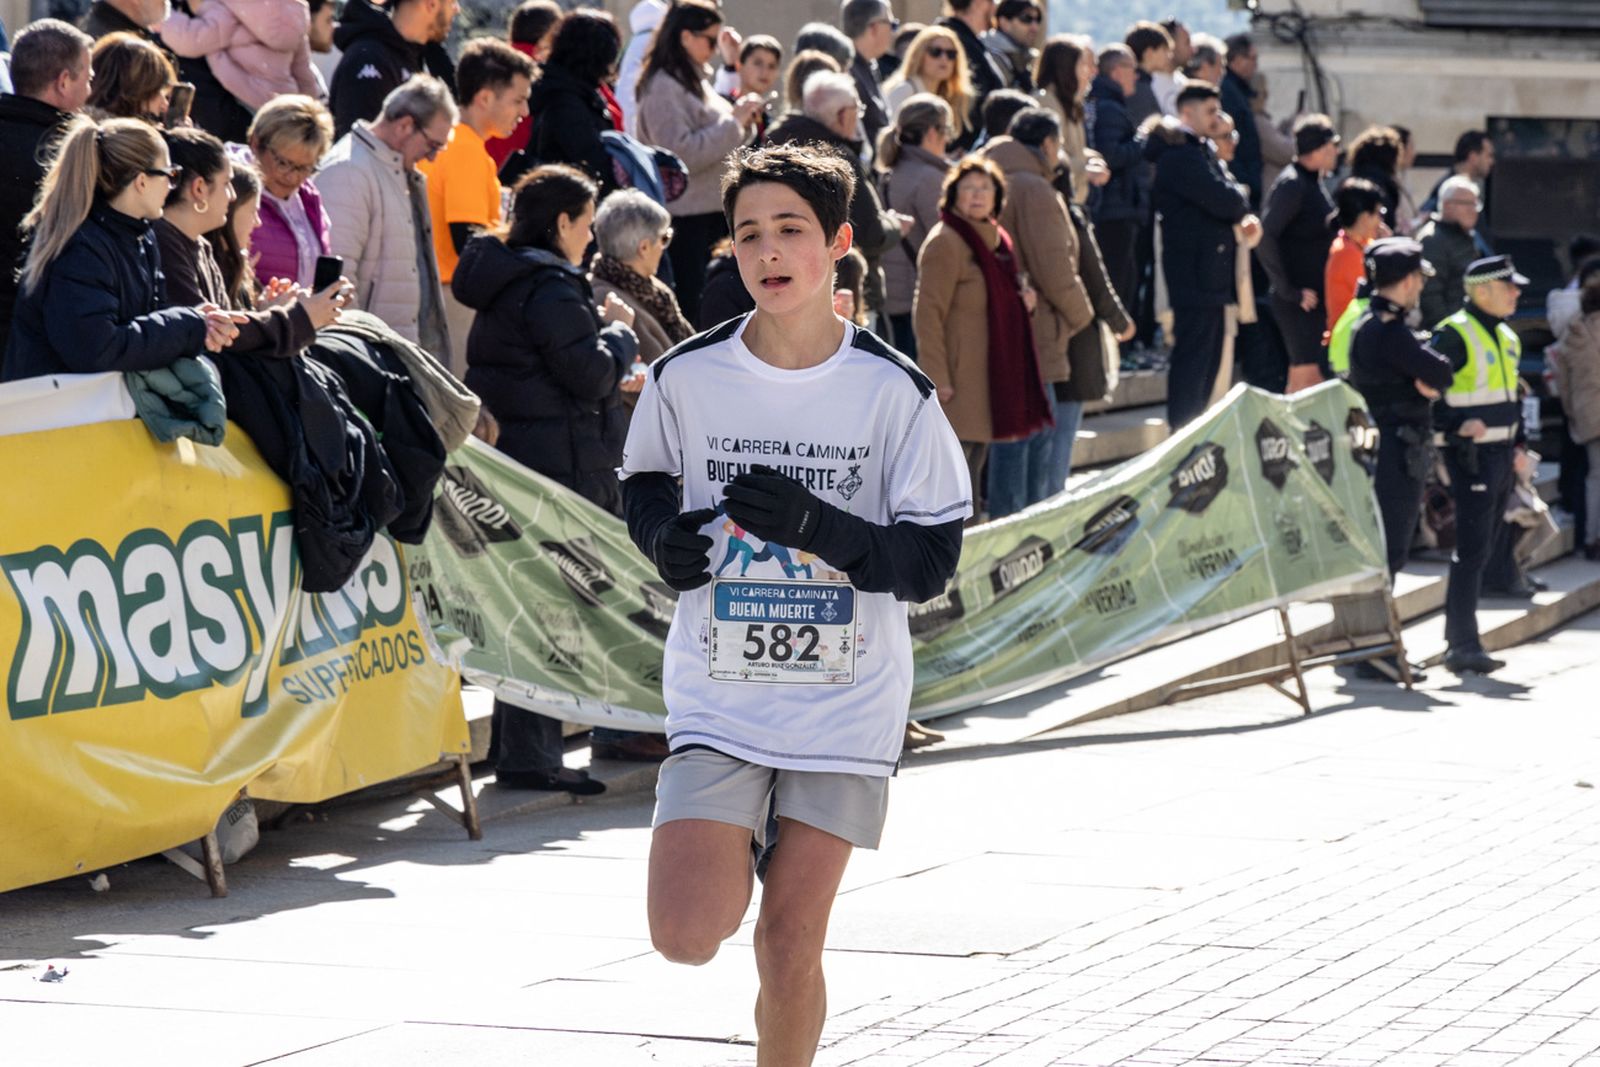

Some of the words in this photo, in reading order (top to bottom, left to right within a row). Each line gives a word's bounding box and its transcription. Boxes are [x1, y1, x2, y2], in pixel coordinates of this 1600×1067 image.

[706, 435, 718, 450] VI
[721, 437, 791, 456] CARRERA
[796, 442, 871, 460] CAMINATA
[706, 459, 747, 483] BUEN
[729, 586, 740, 597] VI
[741, 587, 786, 598] CARRERA
[788, 588, 840, 600] CAMINATA
[729, 601, 766, 618] BUENA
[769, 603, 816, 619] MUERTE
[742, 623, 820, 662] 582
